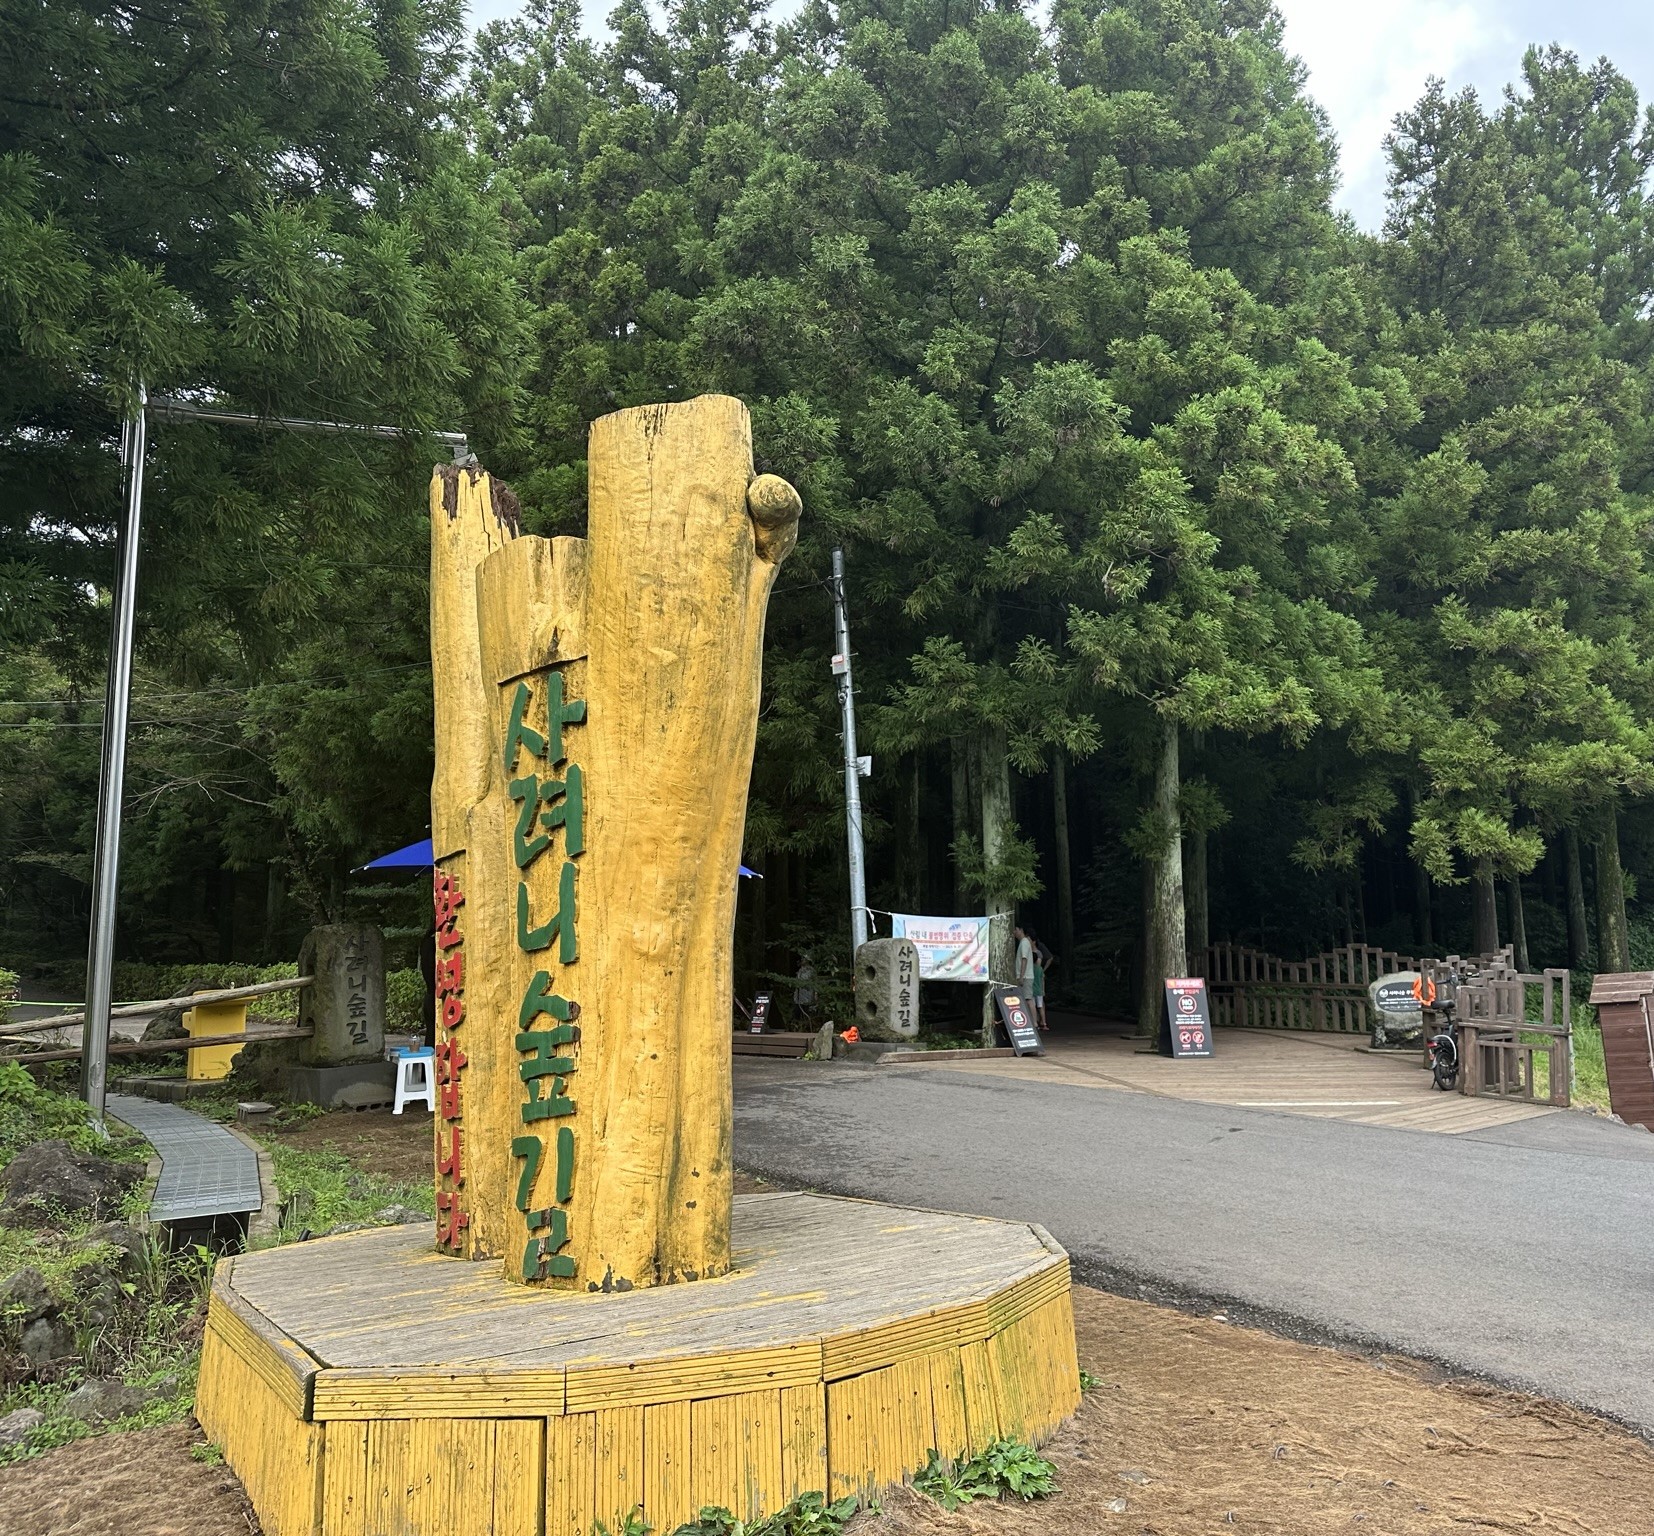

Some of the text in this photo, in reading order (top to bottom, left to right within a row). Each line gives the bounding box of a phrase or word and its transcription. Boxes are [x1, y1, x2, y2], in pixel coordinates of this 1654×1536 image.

[909, 930, 920, 940] 산림
[921, 930, 927, 940] 내
[929, 931, 949, 941] 불법행위
[345, 934, 370, 1046] 사려니숲길
[896, 946, 913, 1028] 사려니숲길
[1181, 998, 1193, 1006] NO
[434, 870, 468, 1249] 환영합니다
